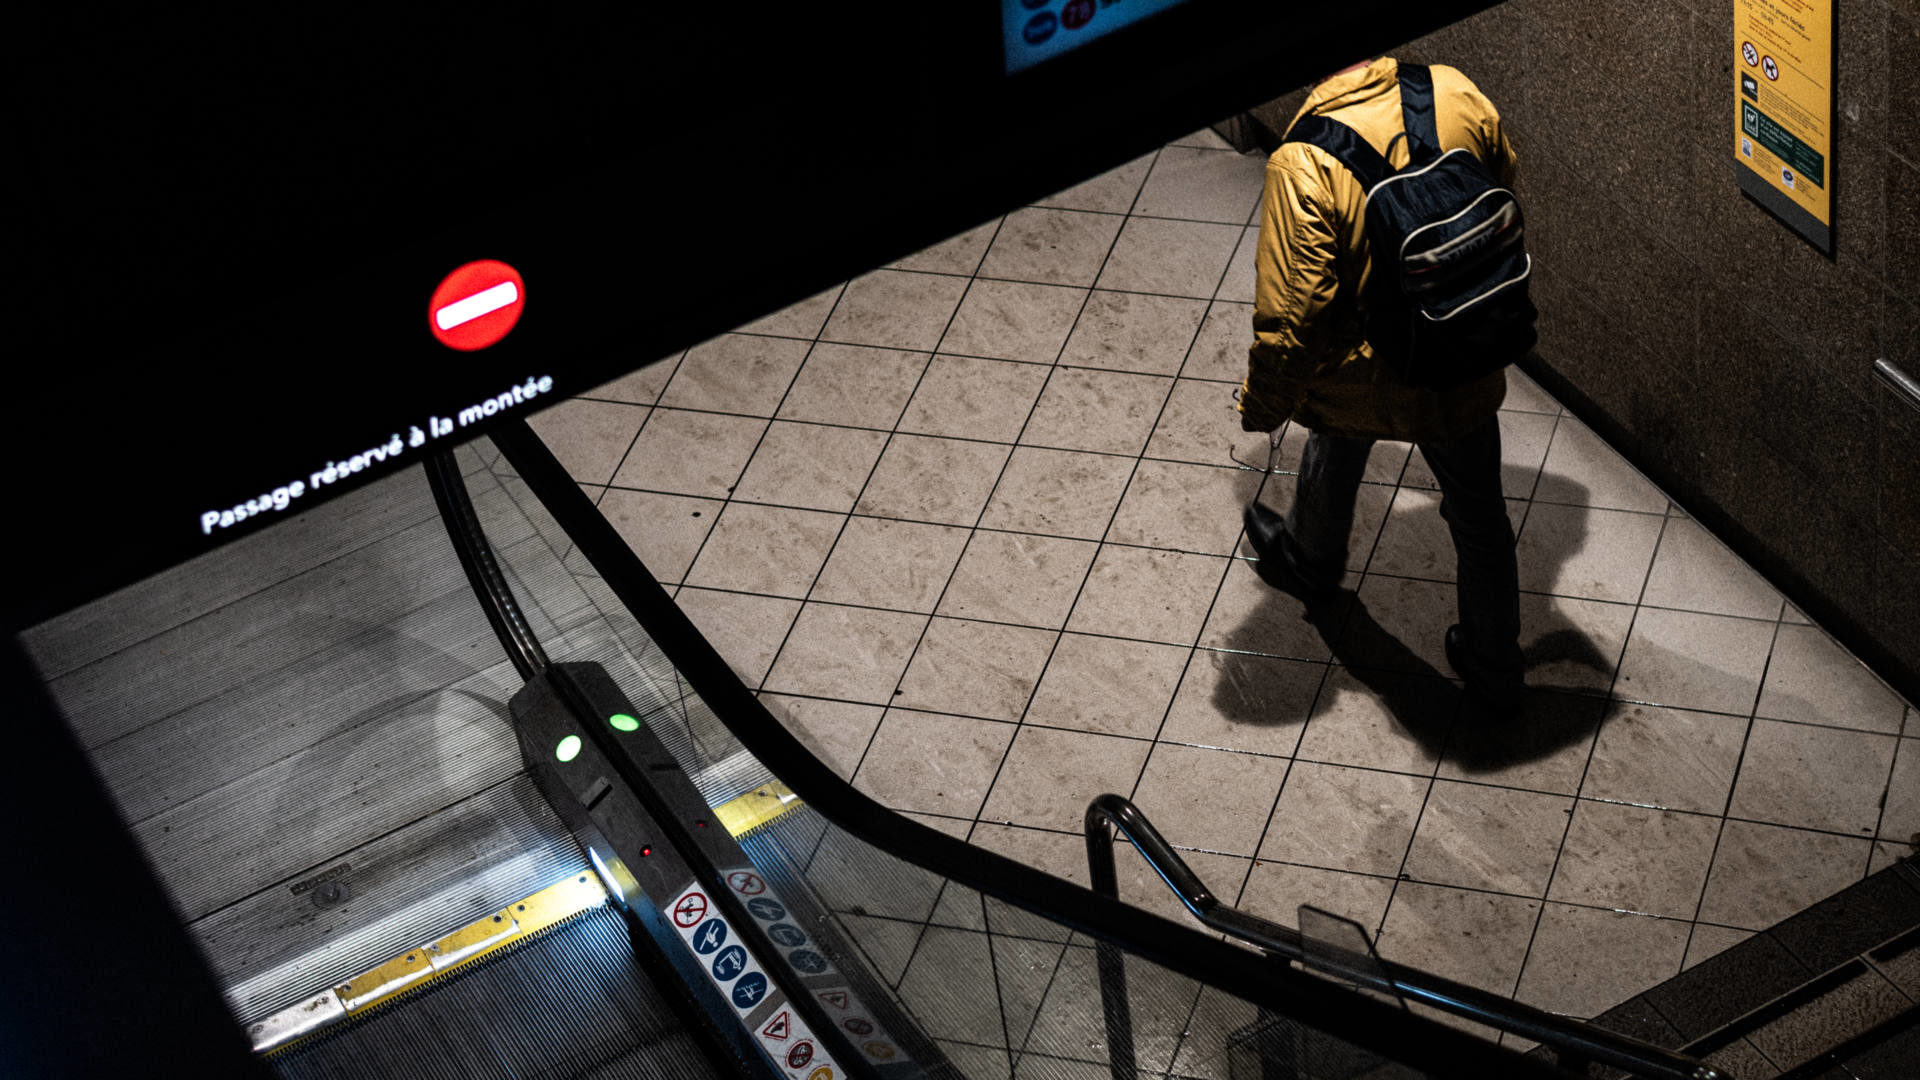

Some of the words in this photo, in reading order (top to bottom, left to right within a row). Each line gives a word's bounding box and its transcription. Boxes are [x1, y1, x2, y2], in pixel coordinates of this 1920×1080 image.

[201, 480, 305, 534] Passage
[310, 433, 403, 489] réservé
[409, 425, 425, 448] à
[430, 416, 453, 438] la
[458, 375, 553, 427] montée
